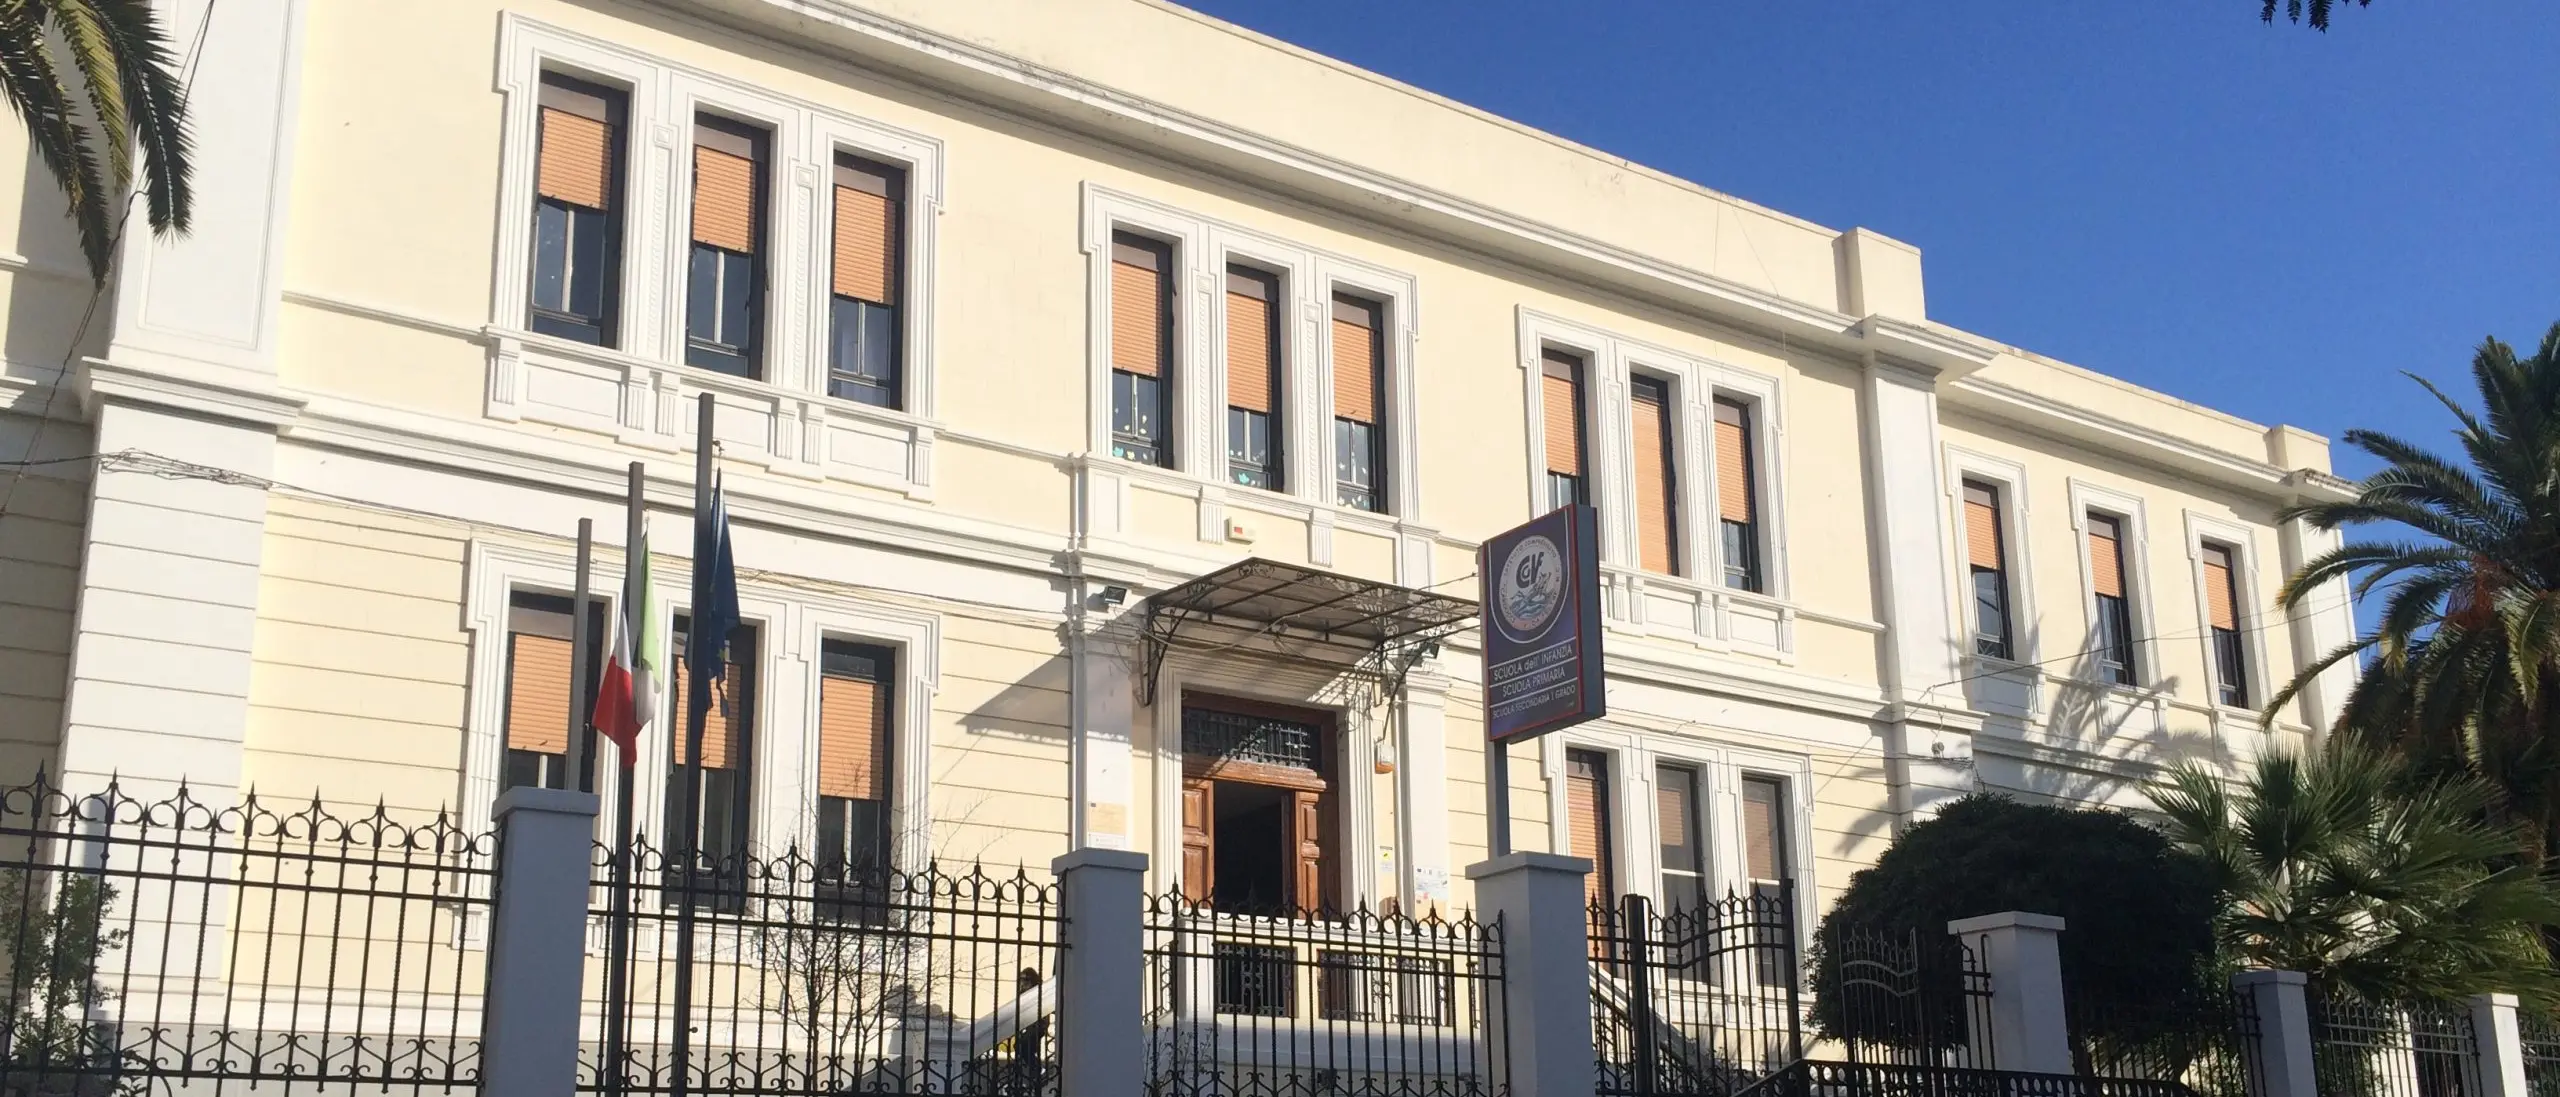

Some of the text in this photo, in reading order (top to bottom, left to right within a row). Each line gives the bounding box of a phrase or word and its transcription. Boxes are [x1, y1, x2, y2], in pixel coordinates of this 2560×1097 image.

[1494, 662, 1523, 681] SCUOLA
[1541, 644, 1572, 664] INFANZIA
[1503, 667, 1565, 697] SCUOLA PRIMARIA
[1492, 705, 1514, 720] SCUOLA
[1516, 693, 1550, 711] SECONDARIA
[1556, 685, 1576, 699] GRADO
